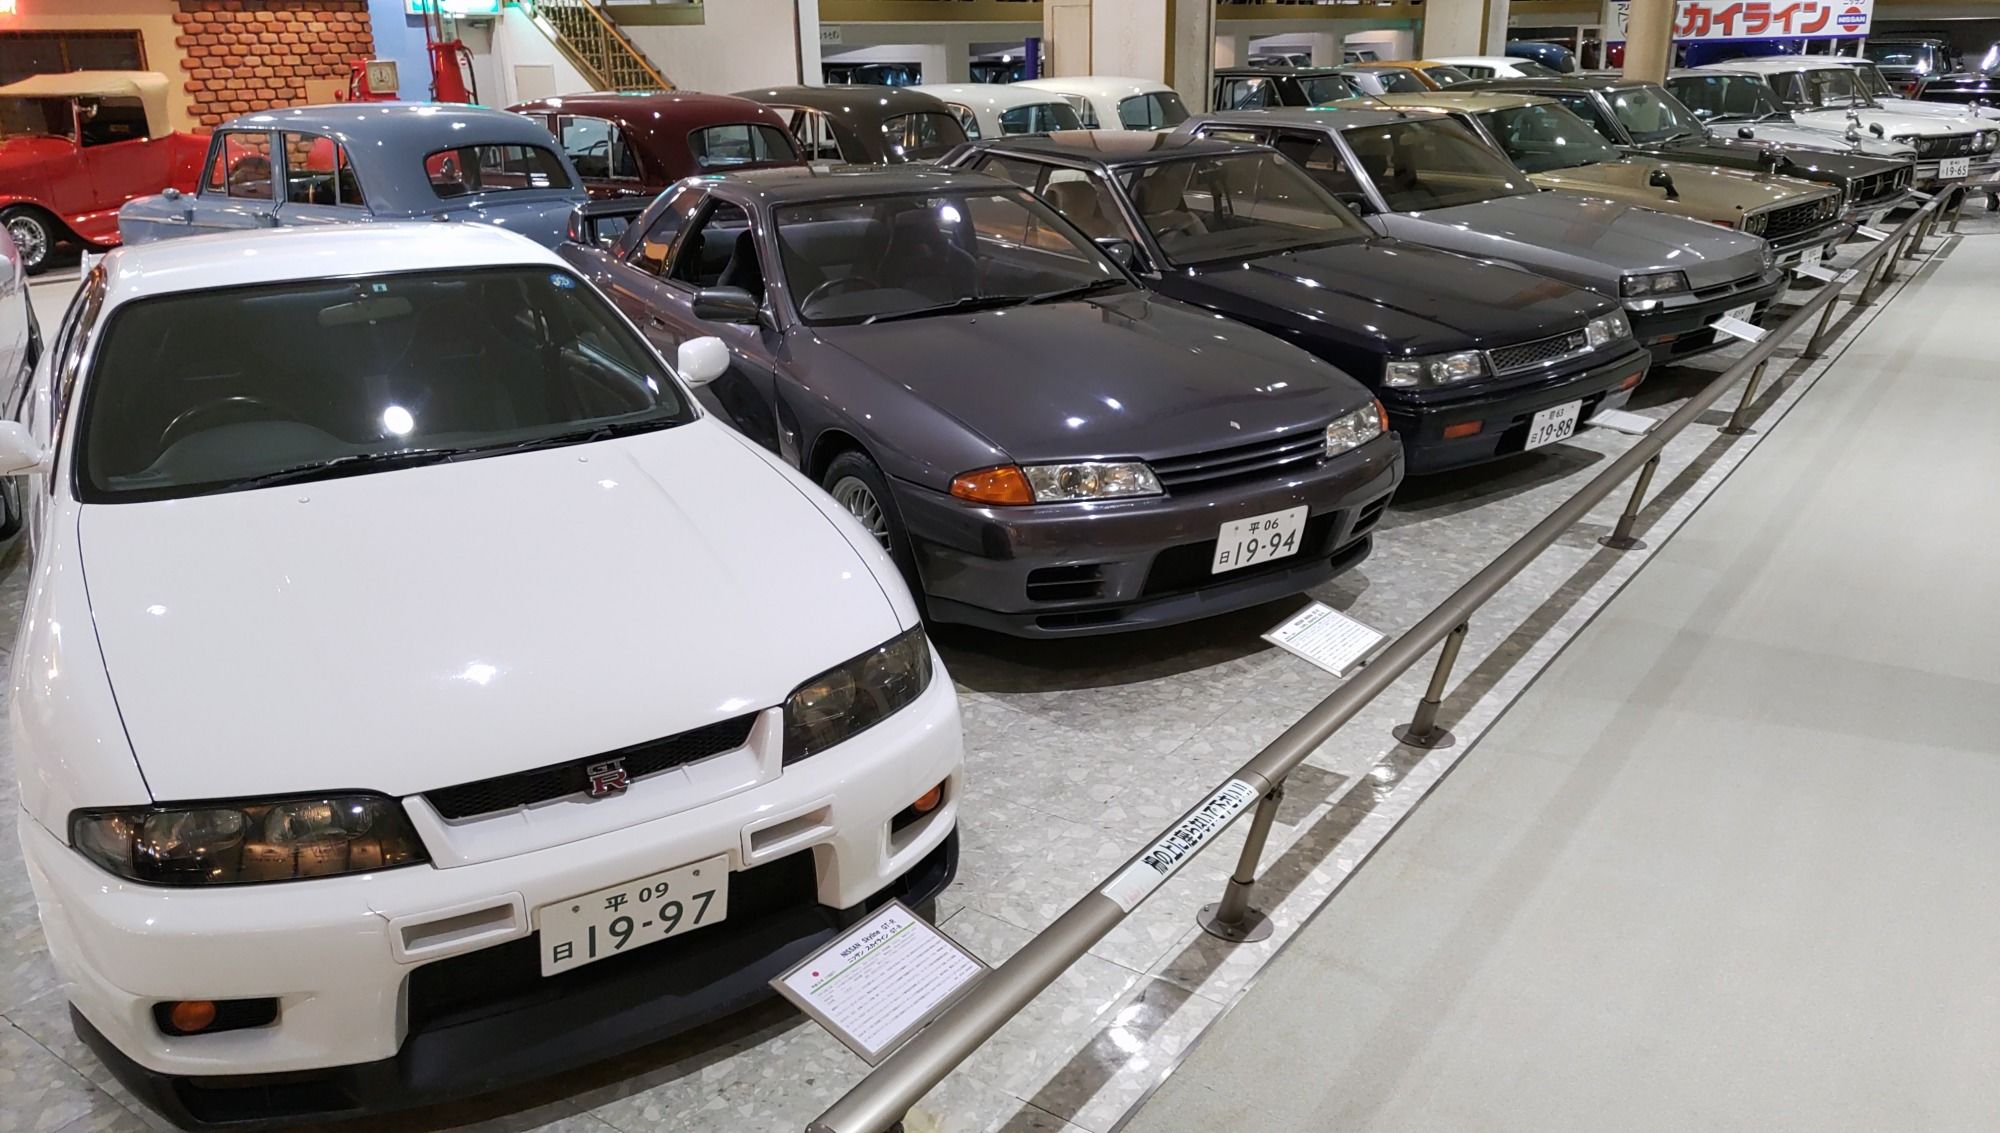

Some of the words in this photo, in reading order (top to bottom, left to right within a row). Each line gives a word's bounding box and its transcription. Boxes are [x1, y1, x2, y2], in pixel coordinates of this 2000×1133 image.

[1839, 15, 1866, 23] NISSAN
[1249, 521, 1260, 534] 平
[1264, 518, 1279, 531] 06
[1219, 551, 1230, 564] 日
[1234, 528, 1296, 566] 19-94
[604, 893, 628, 912] 平
[638, 882, 669, 903] 09
[553, 941, 573, 963] 日
[588, 889, 716, 959] 19-97
